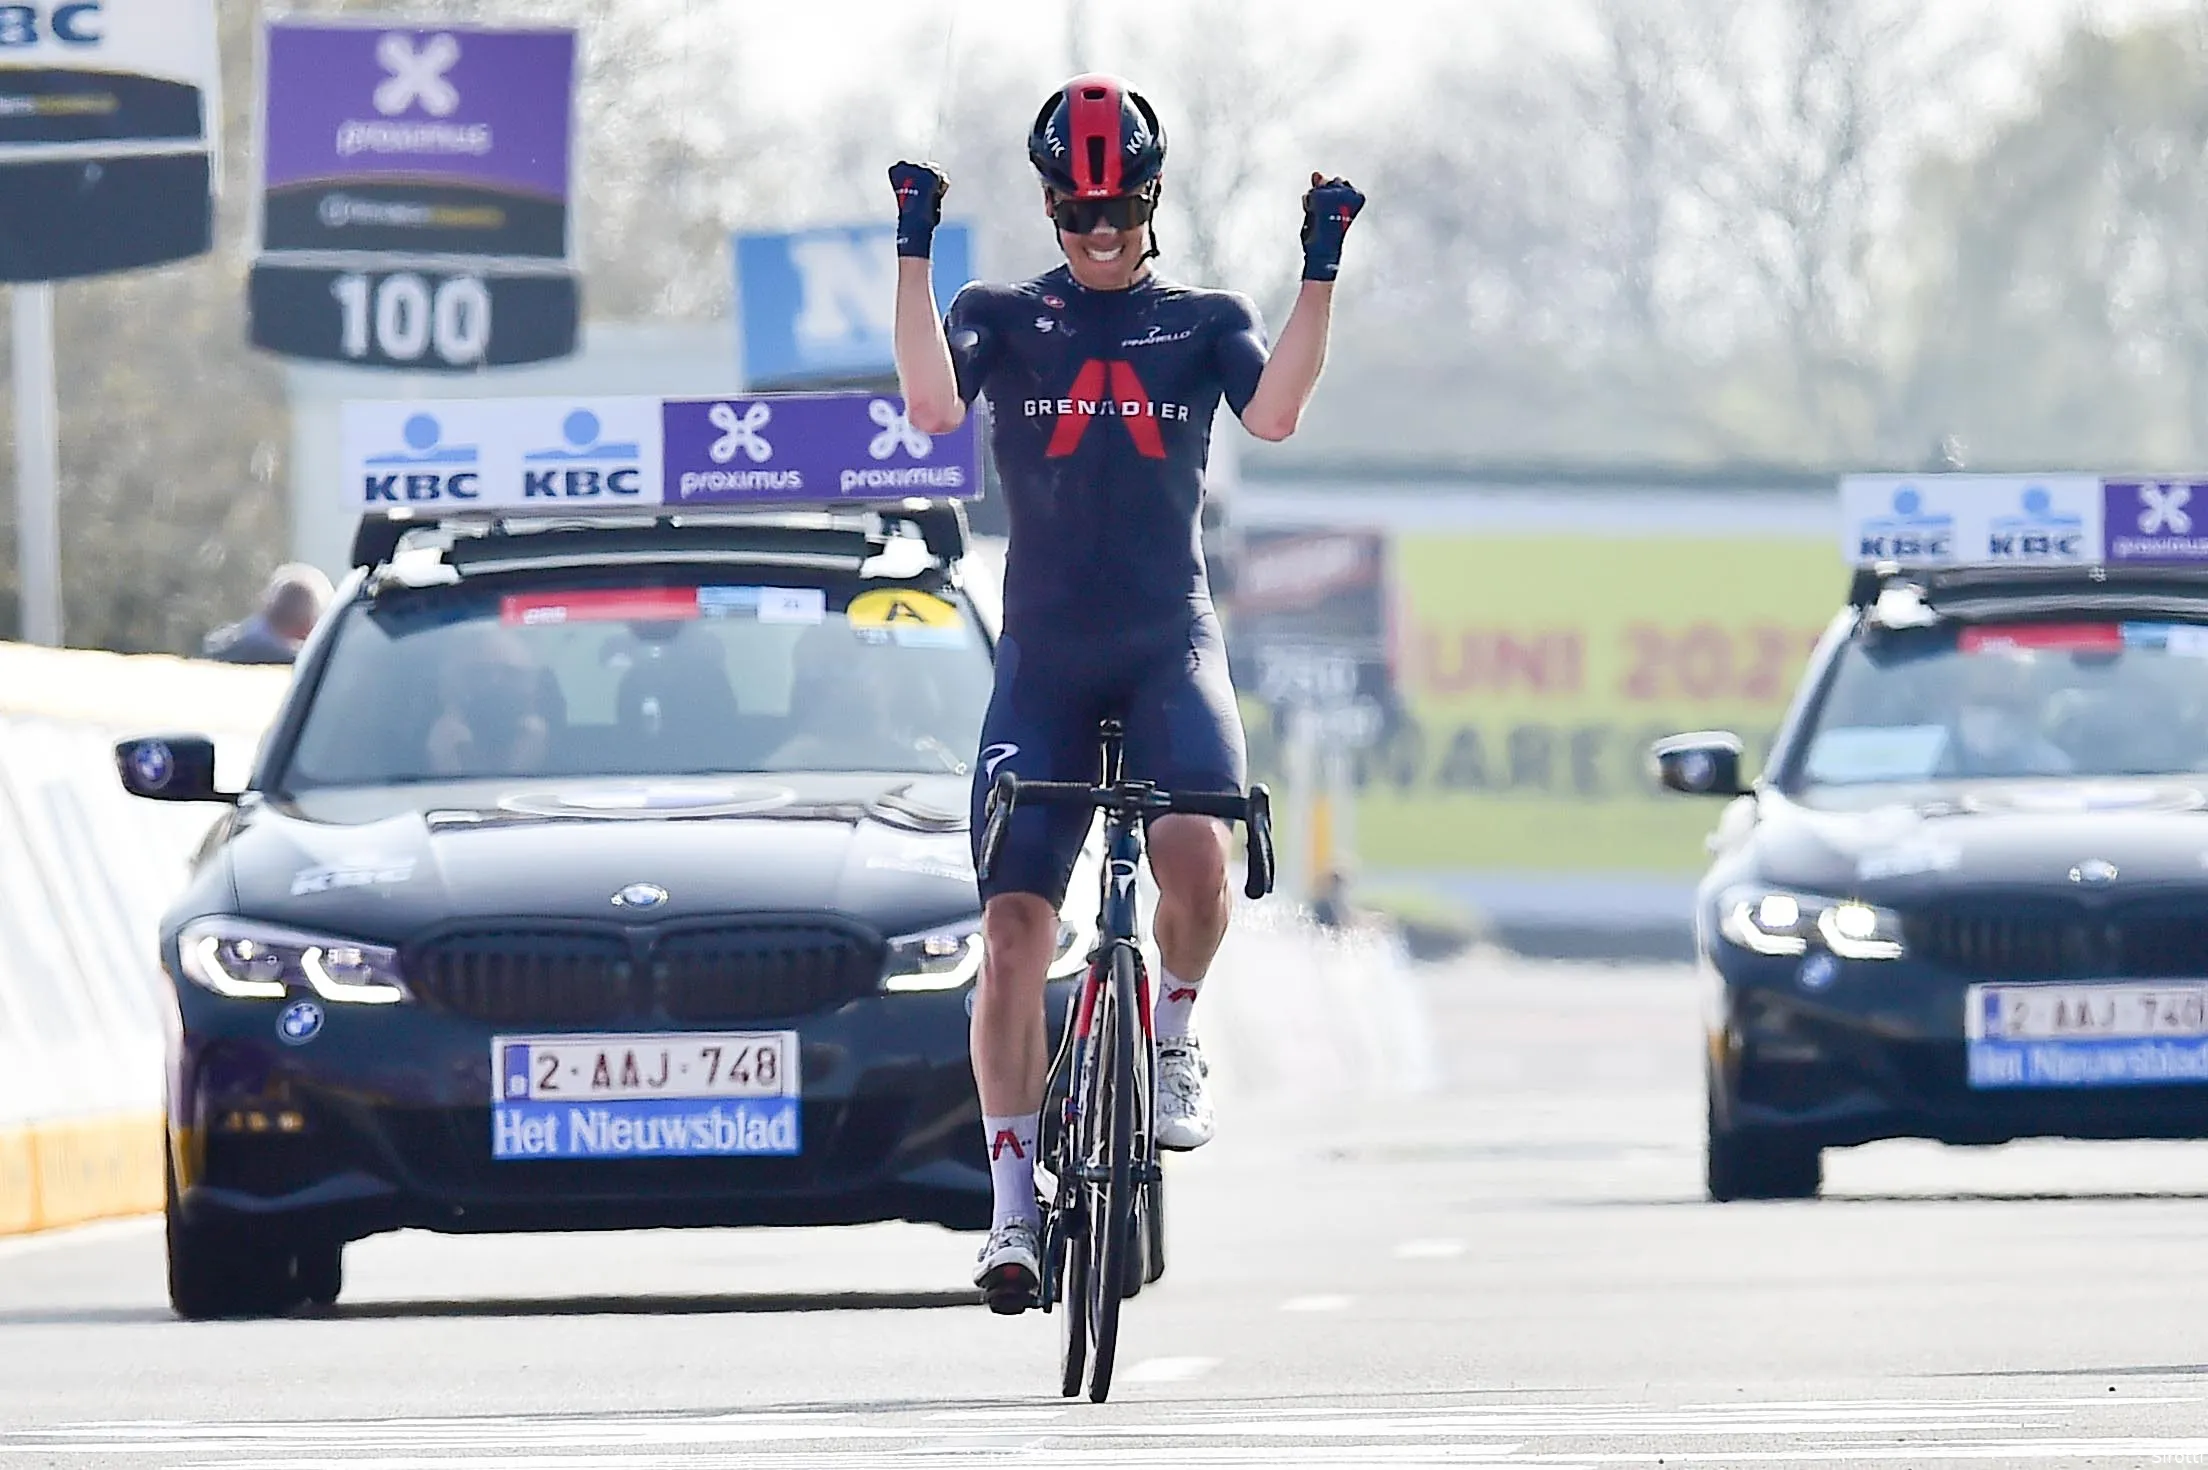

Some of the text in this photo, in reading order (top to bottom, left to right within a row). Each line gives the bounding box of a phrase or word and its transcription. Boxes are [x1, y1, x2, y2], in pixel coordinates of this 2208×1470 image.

[331, 272, 491, 364] 100
[1024, 398, 1190, 422] GRENADIER
[365, 472, 479, 501] KBC
[524, 469, 639, 497] KBC
[680, 470, 803, 499] proximus
[840, 466, 965, 495] proximus
[1860, 534, 1951, 557] KBC
[1990, 532, 2082, 556] KBC
[885, 600, 928, 623] A
[1622, 619, 1822, 700] 202
[497, 1101, 797, 1154] Het Nieuwsblad
